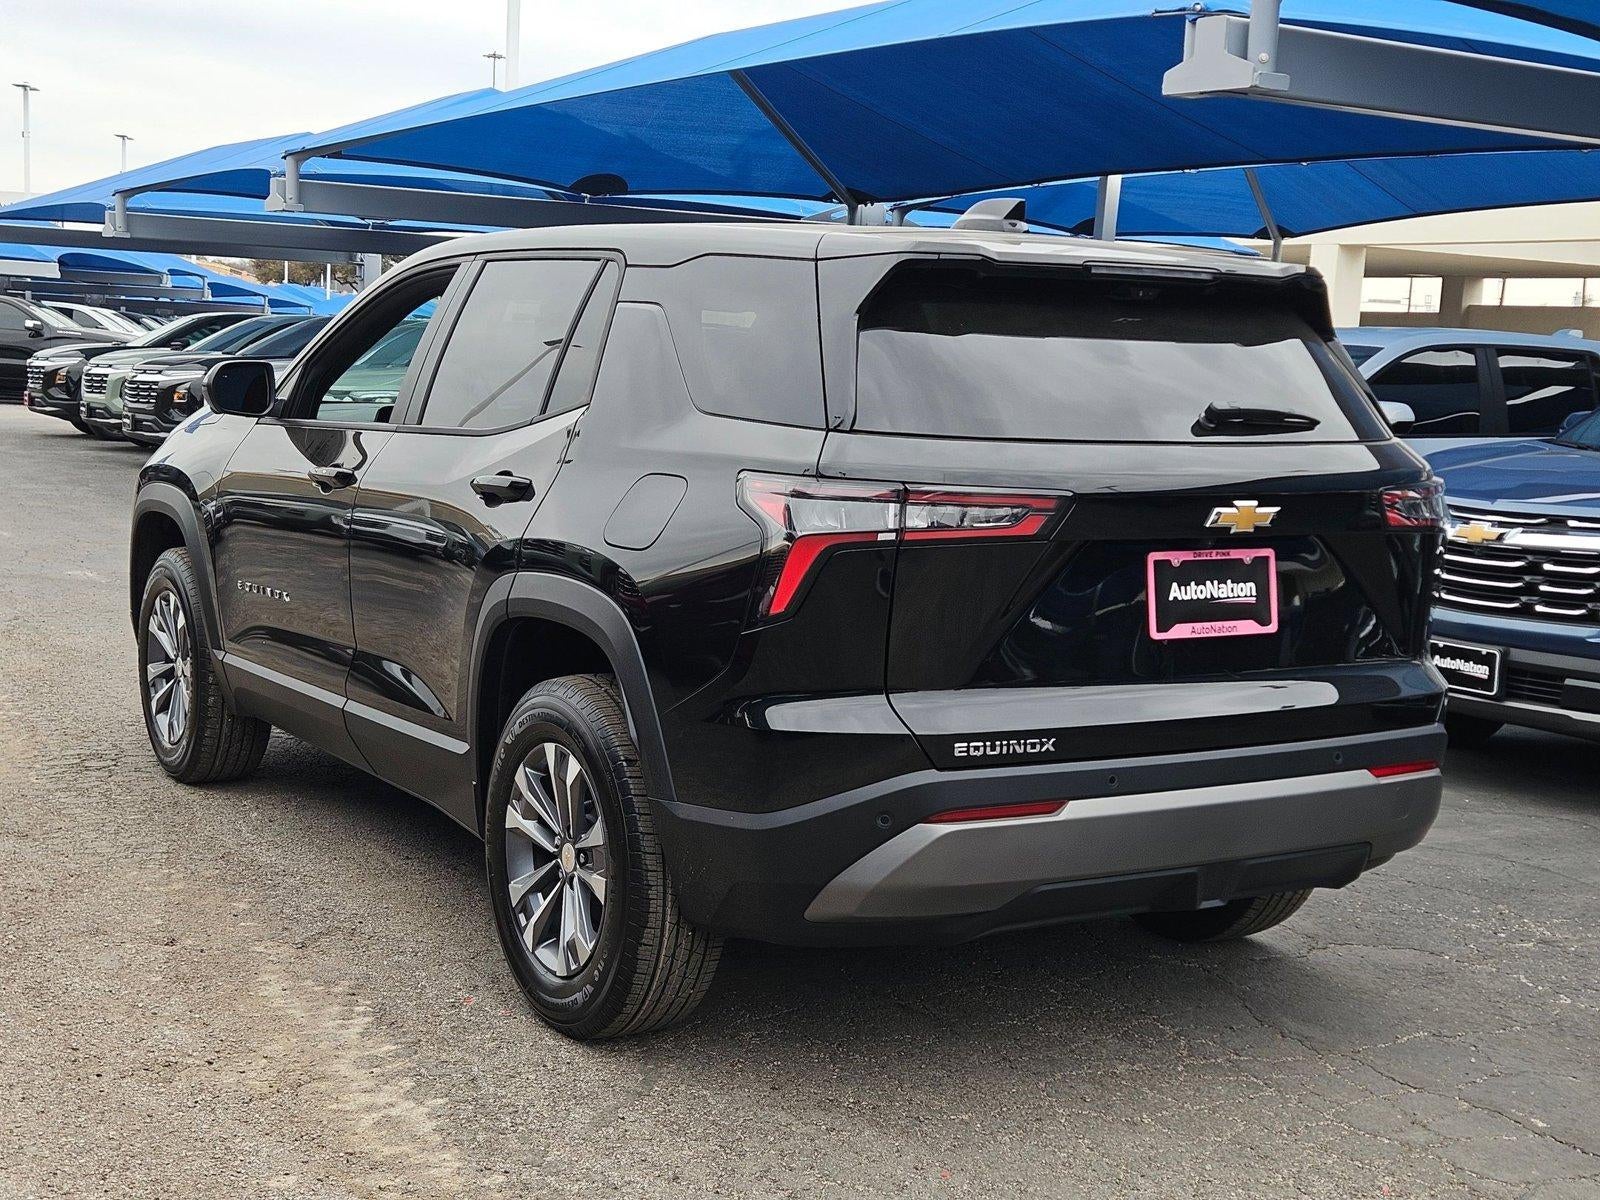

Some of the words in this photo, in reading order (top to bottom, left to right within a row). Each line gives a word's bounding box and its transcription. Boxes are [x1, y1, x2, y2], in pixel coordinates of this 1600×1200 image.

[1192, 551, 1213, 559] DRIVE
[1215, 550, 1232, 558] PINK
[1168, 578, 1257, 601] AutoNation
[1190, 623, 1238, 636] AutoNation
[1432, 654, 1490, 676] AutoNation
[953, 737, 1057, 757] EQUINOX
